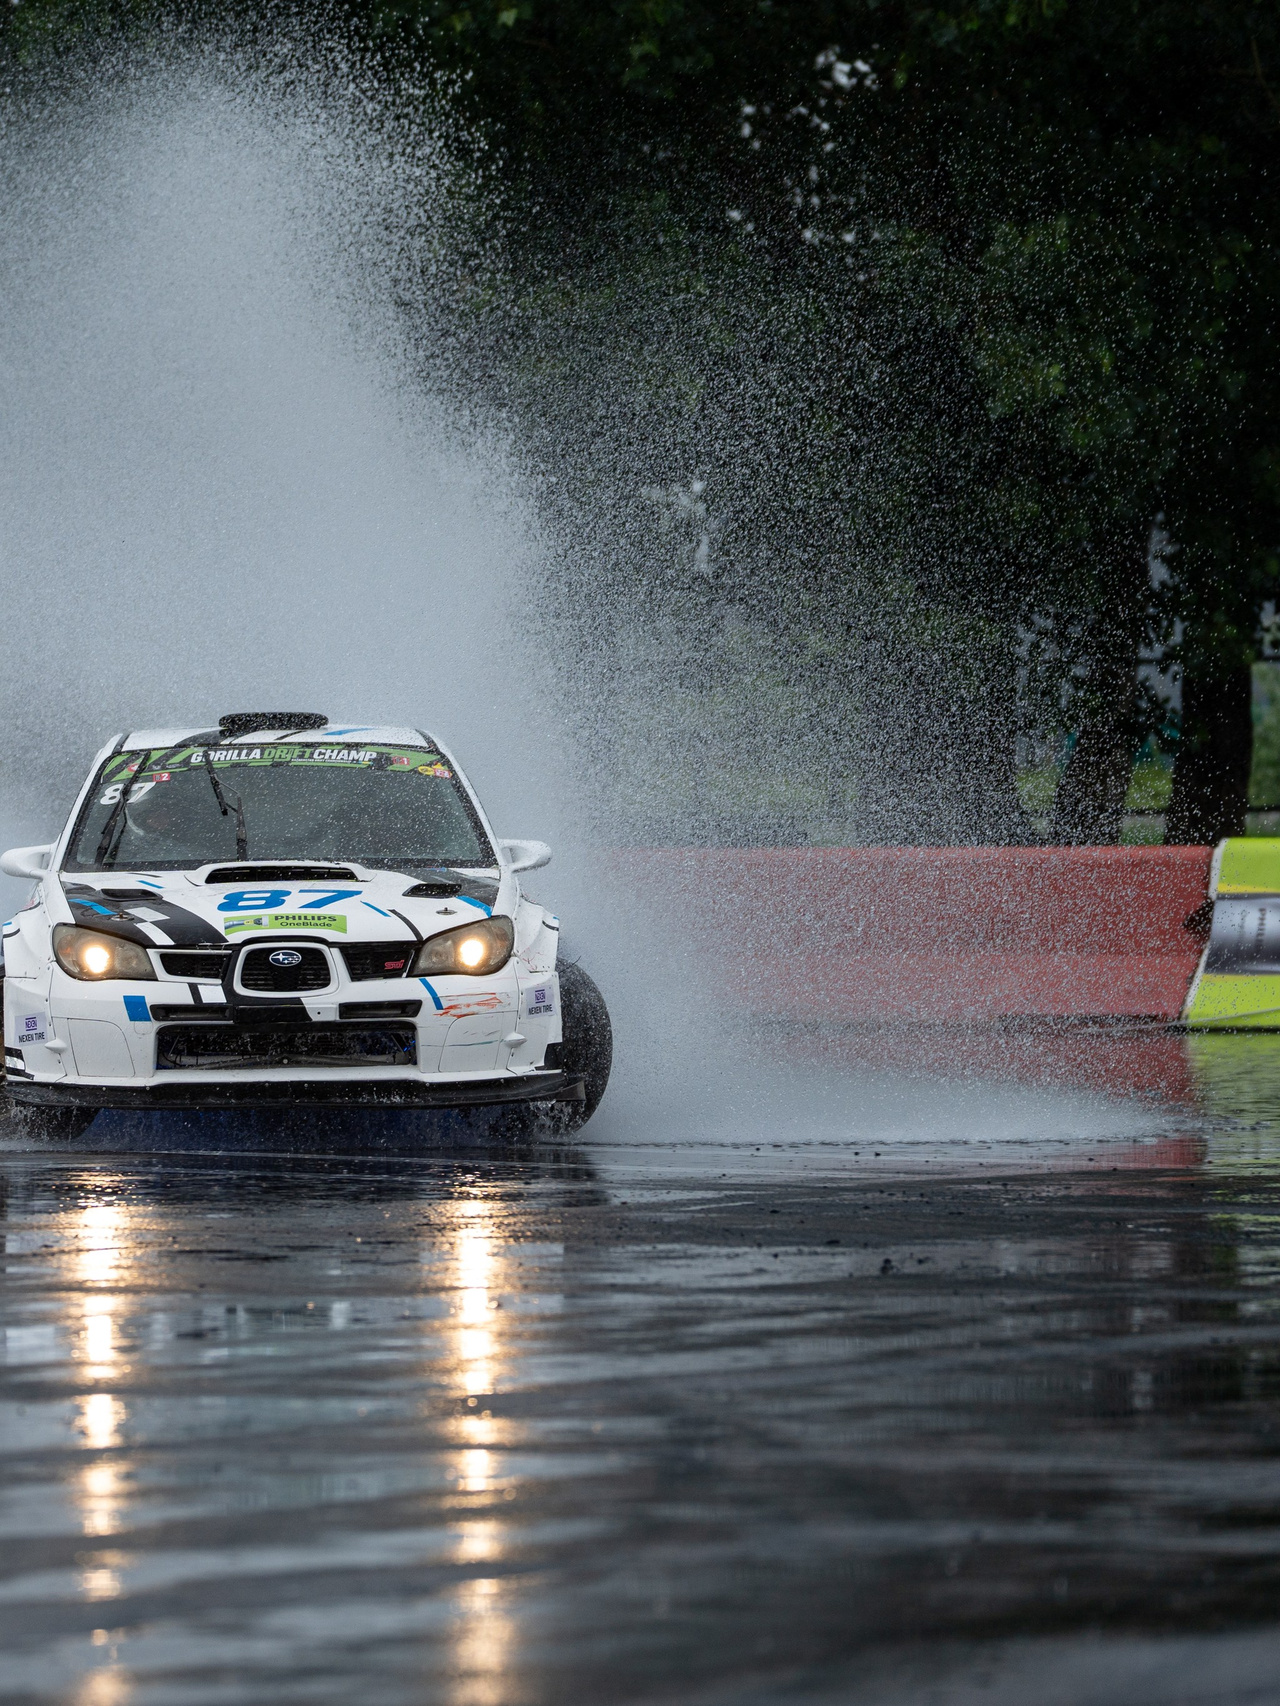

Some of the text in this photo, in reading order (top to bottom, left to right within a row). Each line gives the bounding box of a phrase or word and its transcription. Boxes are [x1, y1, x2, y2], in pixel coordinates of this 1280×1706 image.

[190, 749, 377, 763] GORILLA DRIFT CHAMP
[100, 782, 156, 805] 87
[217, 889, 363, 912] 87
[35, 1032, 45, 1040] TIRE
